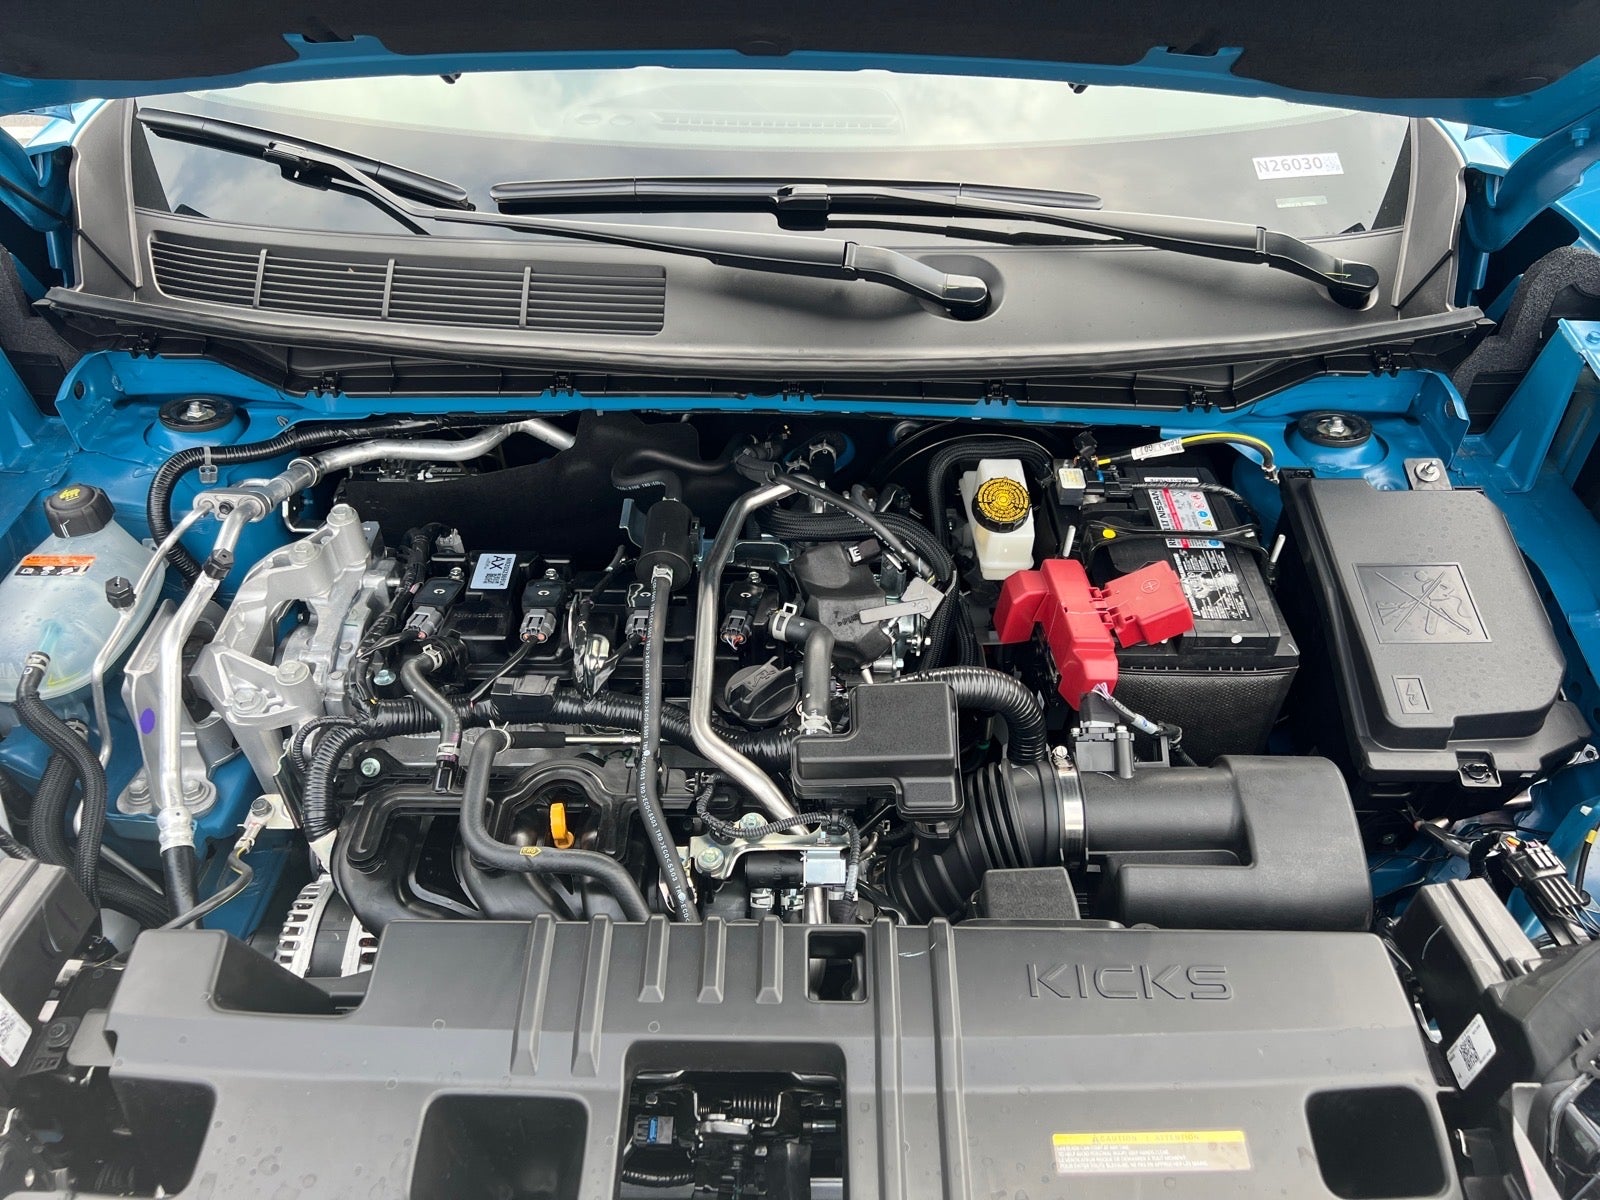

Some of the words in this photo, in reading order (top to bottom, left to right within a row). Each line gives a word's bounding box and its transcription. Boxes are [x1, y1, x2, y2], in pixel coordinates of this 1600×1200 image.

[1256, 156, 1324, 173] N26030
[1152, 490, 1166, 518] NISSAN
[490, 555, 505, 570] AX
[1026, 963, 1234, 1000] KICKS
